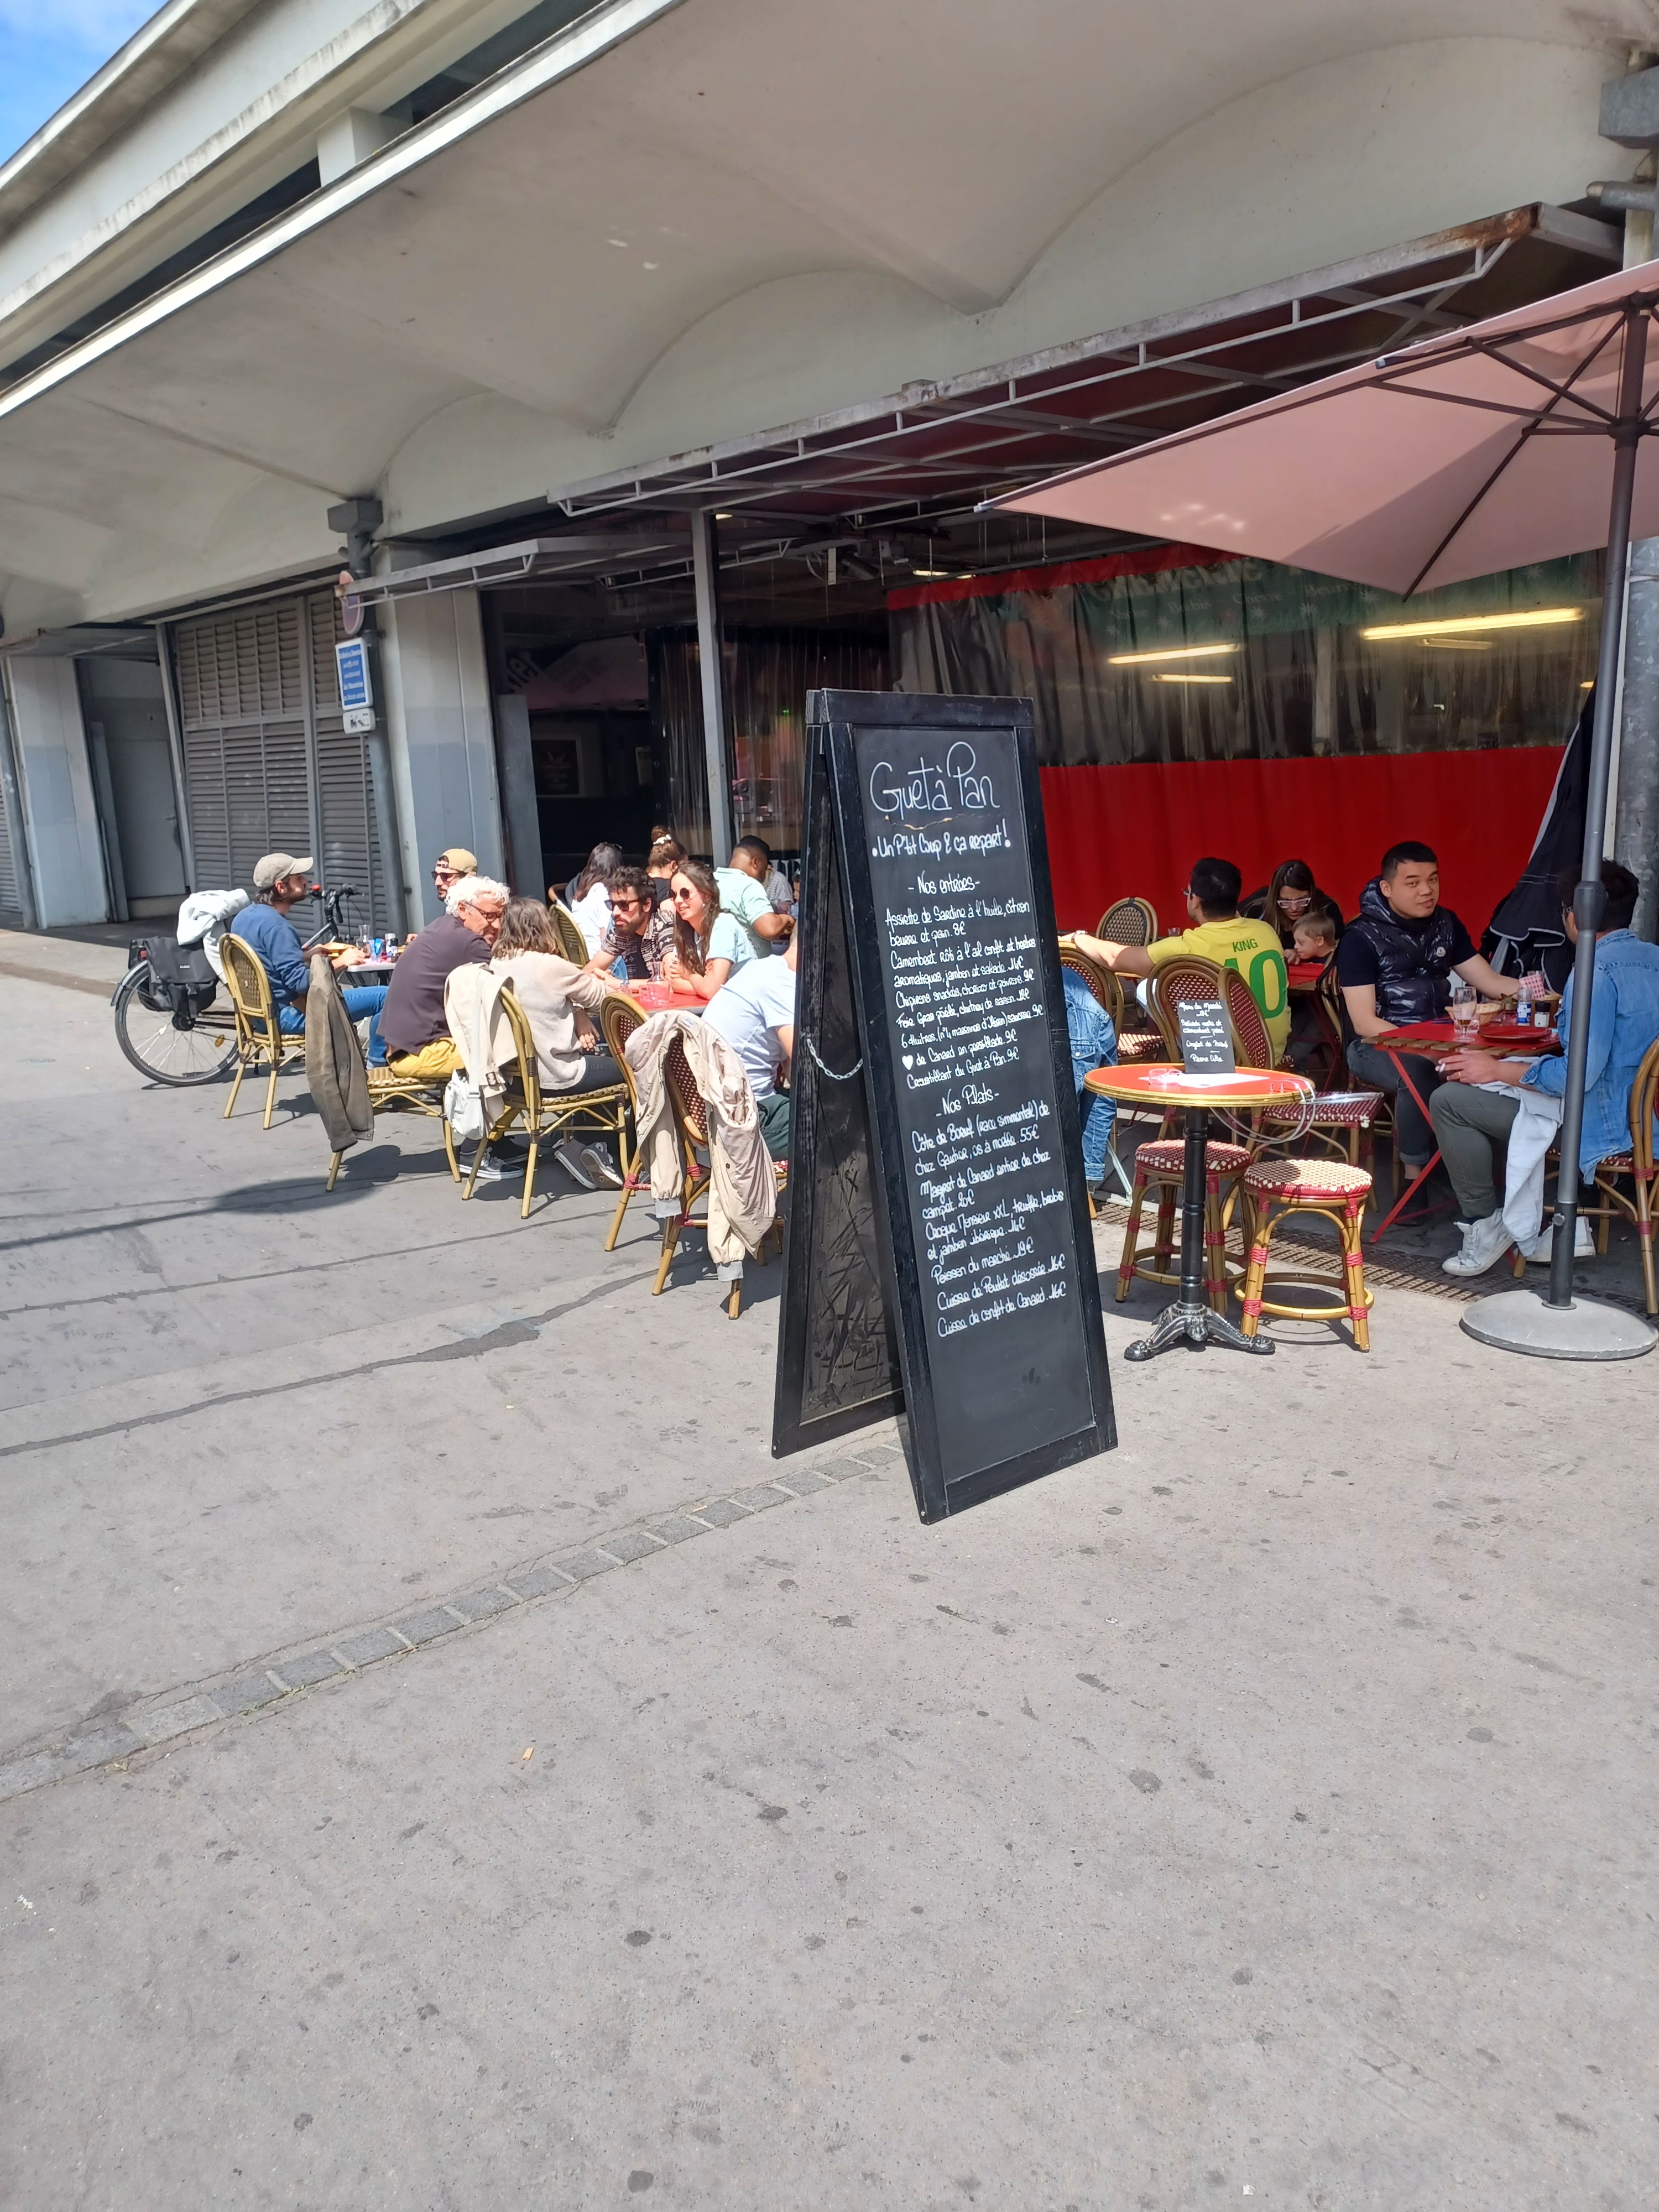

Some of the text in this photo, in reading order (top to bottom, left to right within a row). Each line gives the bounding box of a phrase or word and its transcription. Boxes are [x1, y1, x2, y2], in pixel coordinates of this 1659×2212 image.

[932, 765, 952, 811] à
[946, 742, 1000, 809] Pan
[919, 832, 942, 861] Coup
[885, 907, 920, 933] Assiette
[921, 906, 932, 924] de
[933, 905, 967, 922] Sardine
[968, 904, 975, 918] à
[1005, 896, 1030, 915] citron
[889, 931, 918, 947] beurre
[920, 926, 931, 943] et
[953, 921, 967, 936] 8€
[890, 935, 1037, 970] Camembert rôti à l'ail confit et herbes
[1232, 938, 1258, 952] KING
[895, 990, 932, 1012] Chipirons
[961, 982, 988, 996] chorizo
[988, 978, 998, 990] et
[1023, 968, 1035, 982] 9€
[944, 964, 971, 988] jambon
[972, 962, 981, 978] et
[1008, 955, 1025, 970] 14€
[895, 1012, 916, 1029] Foie
[917, 1011, 935, 1027] Gras
[958, 999, 985, 1015] chutney
[984, 997, 994, 1009] de
[901, 1033, 909, 1048] 6
[951, 1023, 982, 1037] marennes
[1032, 1004, 1044, 1017] 9€
[906, 1065, 953, 1090] Croustillant
[955, 1063, 966, 1077] du
[966, 1059, 984, 1077] Guet
[984, 1056, 991, 1070] à
[1006, 1046, 1020, 1062] 9€
[916, 1053, 927, 1067] de
[927, 1045, 956, 1063] Canard
[957, 1046, 968, 1056] en
[1005, 1029, 1018, 1044] 9€
[911, 1130, 936, 1154] Côte
[936, 1128, 948, 1146] de
[1039, 1099, 1051, 1117] de
[915, 1156, 936, 1176] chez
[972, 1144, 984, 1158] os
[984, 1139, 992, 1154] à
[1019, 1123, 1040, 1144] 55€
[920, 1147, 1052, 1204] Magret de Canard entier de chez
[925, 1222, 958, 1244] Croque
[957, 1211, 992, 1237] Monsieur
[1040, 1187, 1065, 1207] brebis
[957, 1188, 976, 1208] 20€
[927, 1243, 938, 1261] et
[937, 1237, 967, 1265] jambon
[1008, 1215, 1026, 1234] 14€
[931, 1264, 967, 1286] Poisson
[967, 1255, 980, 1274] du
[1013, 1236, 1035, 1259] 19€
[937, 1291, 971, 1311] Cuisse
[971, 1282, 984, 1300] de
[980, 1272, 1011, 1295] Poulet
[1047, 1253, 1066, 1272] 16€
[937, 1317, 968, 1338] Cuisse
[968, 1308, 980, 1326] de
[980, 1299, 1005, 1321] confit
[1004, 1297, 1017, 1314] de
[1048, 1281, 1067, 1300] 16€
